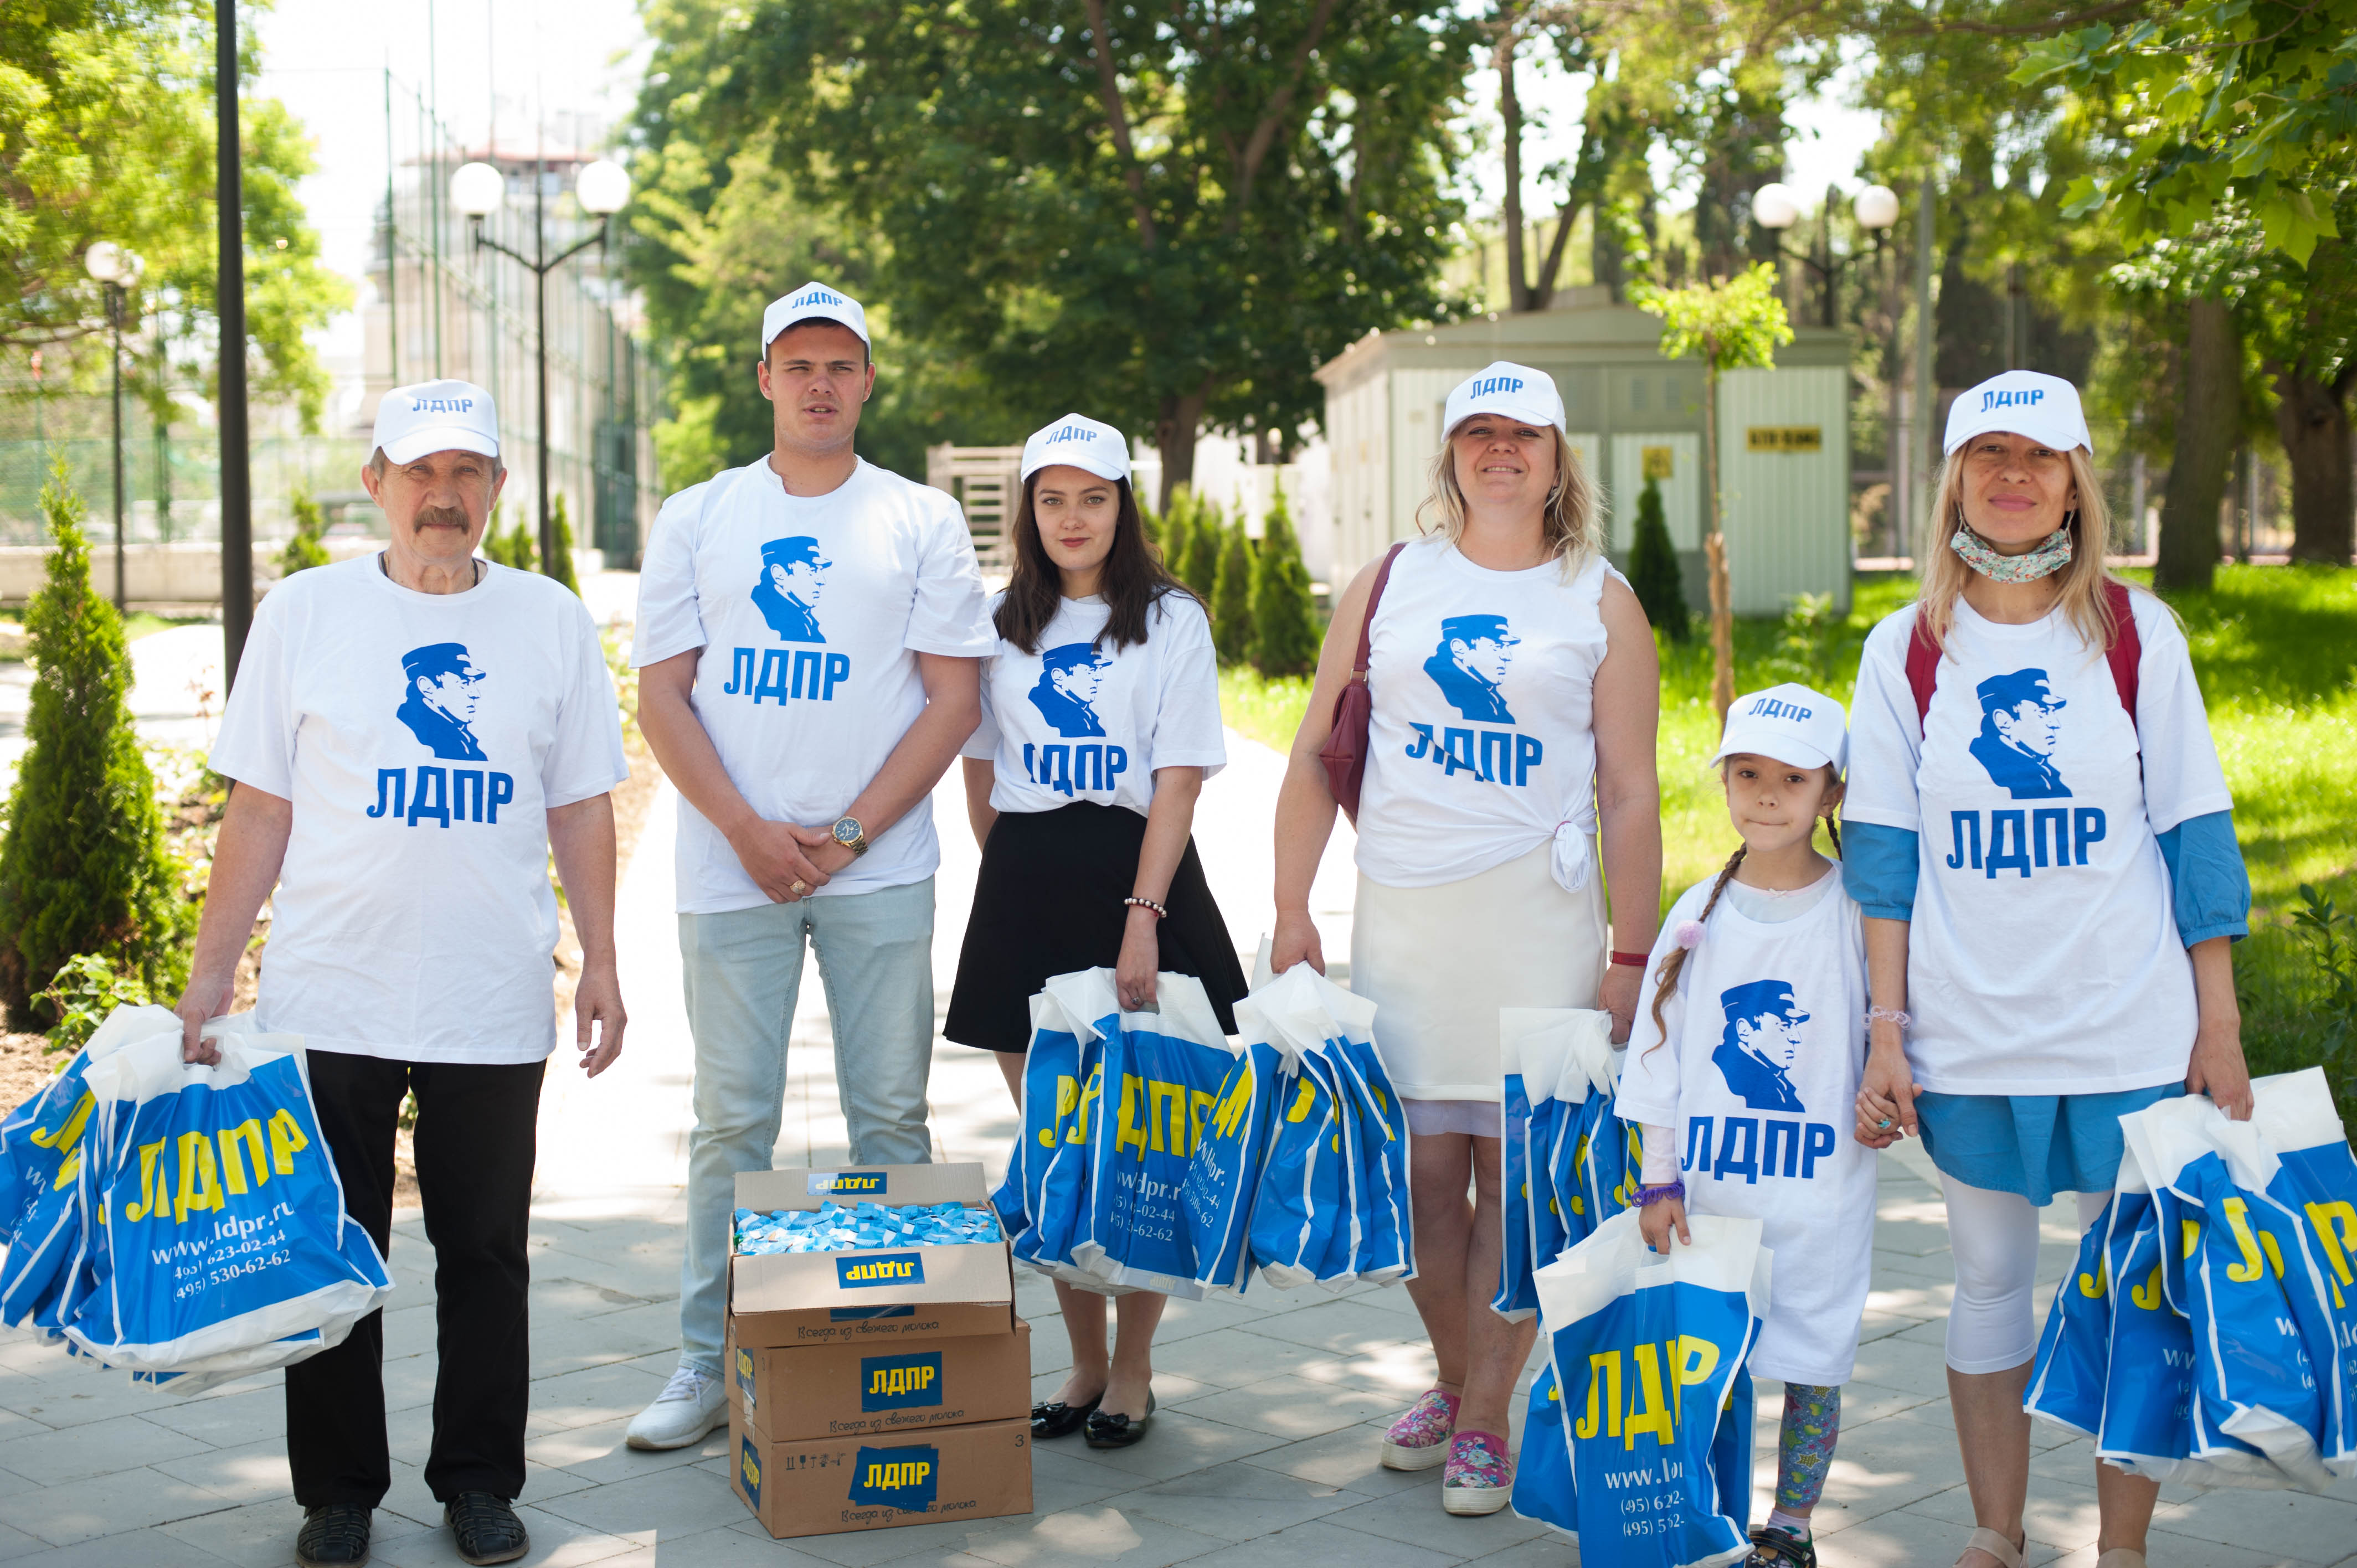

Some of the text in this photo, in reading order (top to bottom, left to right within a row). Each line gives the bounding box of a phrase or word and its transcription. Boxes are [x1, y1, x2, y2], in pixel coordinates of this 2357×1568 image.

[792, 292, 842, 309] ЛДПР
[1470, 376, 1524, 400] ЛДПР
[1980, 389, 2045, 412] ЛДПР
[413, 398, 472, 413] ЛДПР
[1046, 426, 1097, 445] ЛДПР
[724, 646, 850, 706] ЛДПР
[1749, 698, 1813, 723] ЛДПР
[1405, 721, 1543, 787] ЛДПР
[366, 766, 514, 828] ЛДПР
[1946, 807, 2107, 879] ЛДПР
[1680, 1116, 1836, 1185] ЛДПР
[126, 1109, 310, 1226] ЛДПР
[815, 1177, 880, 1190] ЛДПР
[151, 1201, 296, 1265] www.ldpr.ru
[207, 1229, 286, 1265] 623-02-44
[173, 1249, 291, 1303] (495) 530-62-62
[846, 1261, 915, 1280] ЛДПР
[797, 1321, 940, 1342] Всегда из свежего молока
[868, 1365, 935, 1396] ЛДПР
[829, 1410, 964, 1436] Всегда из свежего молока
[1015, 1434, 1025, 1447] 3
[863, 1461, 930, 1491] ЛДПР
[841, 1510, 878, 1525] Всегда
[882, 1509, 894, 1523] из
[940, 1500, 977, 1514] молока
